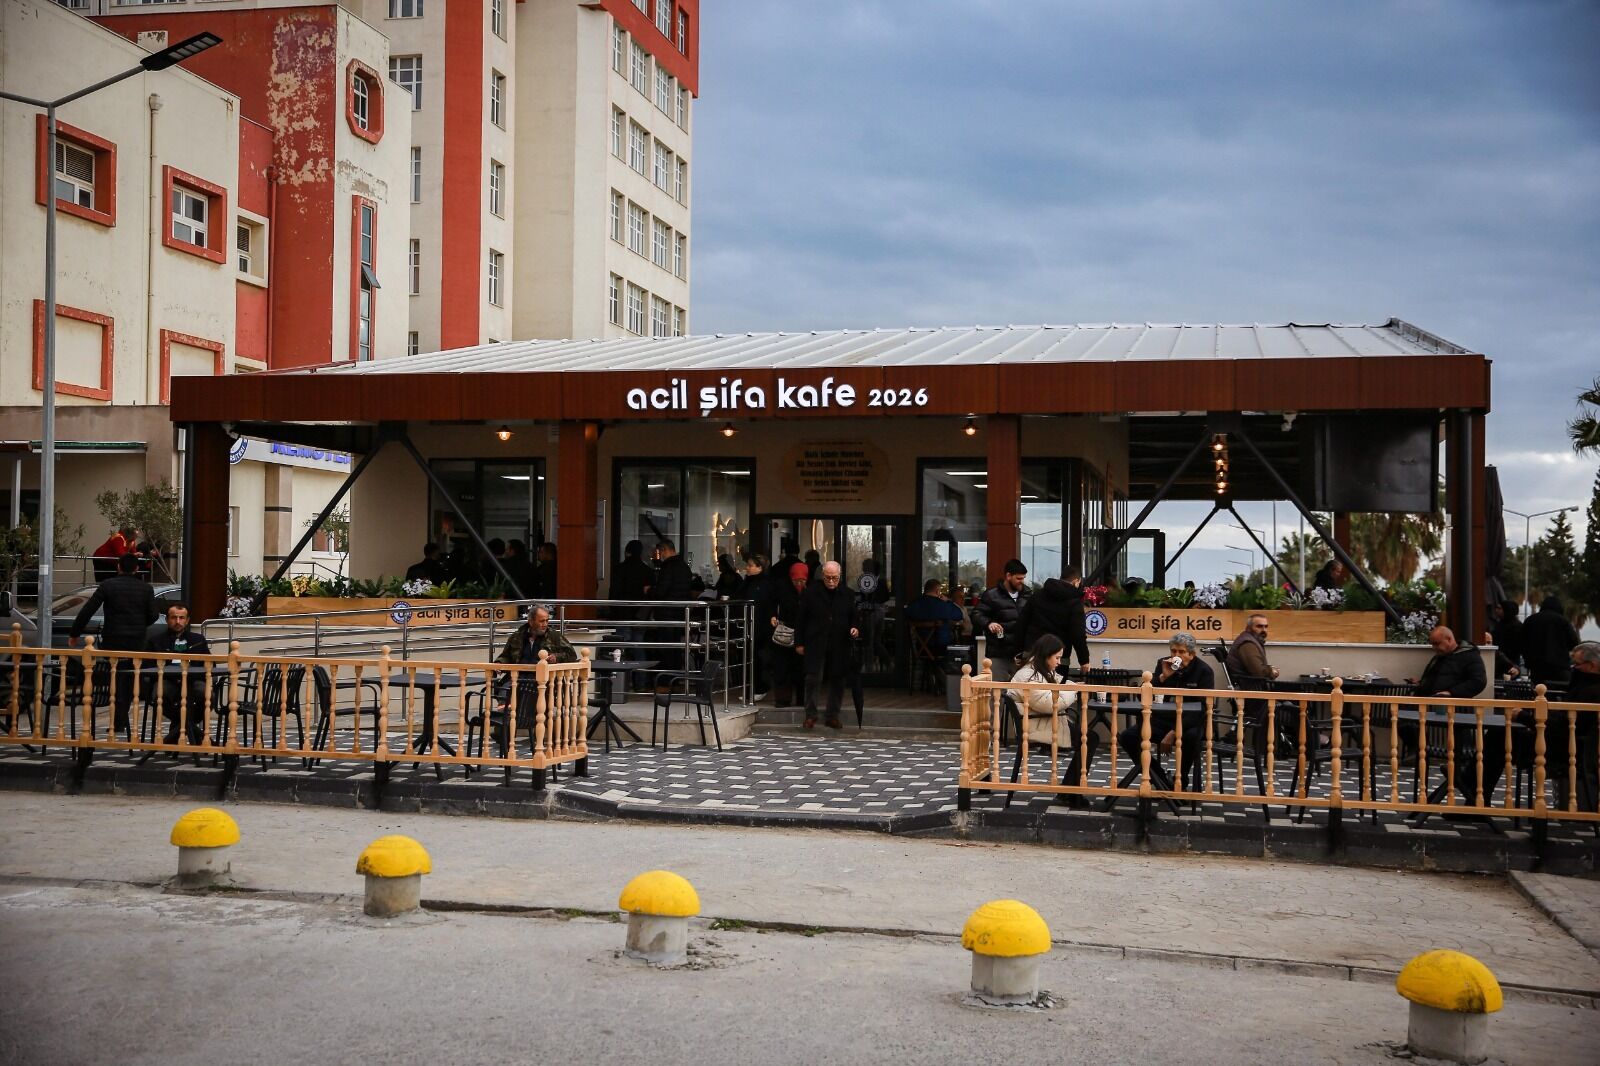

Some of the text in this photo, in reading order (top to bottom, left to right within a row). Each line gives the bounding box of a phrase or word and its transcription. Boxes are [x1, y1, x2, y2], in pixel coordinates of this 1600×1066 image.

[627, 376, 929, 417] acil şifa kafe 2026
[1118, 615, 1145, 630] acil
[1151, 615, 1180, 633] şifa
[1187, 616, 1222, 631] kafe
